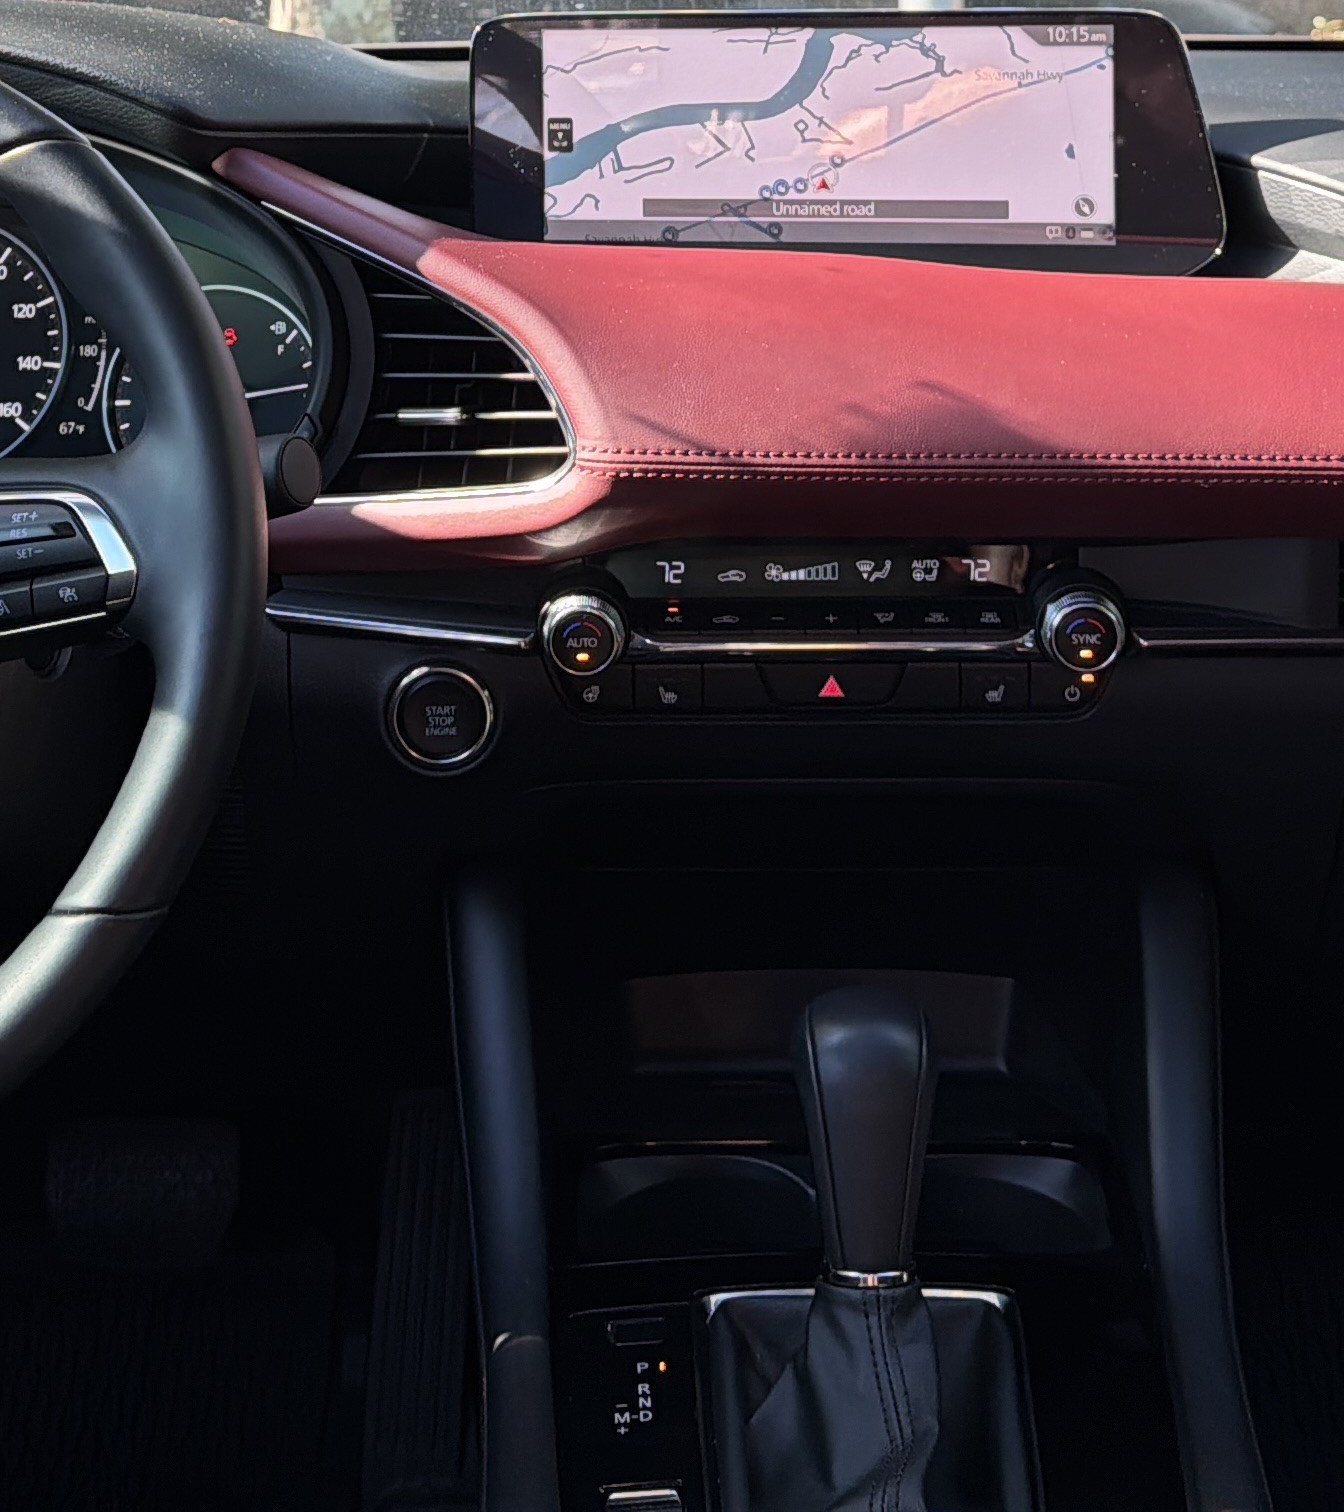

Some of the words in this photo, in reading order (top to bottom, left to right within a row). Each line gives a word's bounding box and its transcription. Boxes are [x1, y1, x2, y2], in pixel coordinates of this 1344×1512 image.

[975, 69, 1034, 81] Savannah
[1037, 69, 1064, 84] Hwy
[771, 200, 840, 216] Unnamed
[842, 200, 875, 216] road
[11, 303, 37, 319] 120
[78, 344, 99, 358] 180
[277, 344, 285, 356] F
[16, 355, 43, 372] 140
[77, 396, 86, 407] 0
[10, 528, 28, 538] RES
[912, 558, 940, 569] AUTO
[656, 561, 685, 583] 72
[960, 560, 991, 582] 72
[664, 615, 683, 623] A/C
[566, 637, 598, 648] AUTO
[1071, 633, 1102, 645] SYNC
[425, 705, 457, 716] START
[428, 716, 455, 727] STOP
[425, 726, 457, 737] ENGINE
[636, 1362, 650, 1375] P
[637, 1383, 651, 1396] R
[638, 1395, 652, 1409] N
